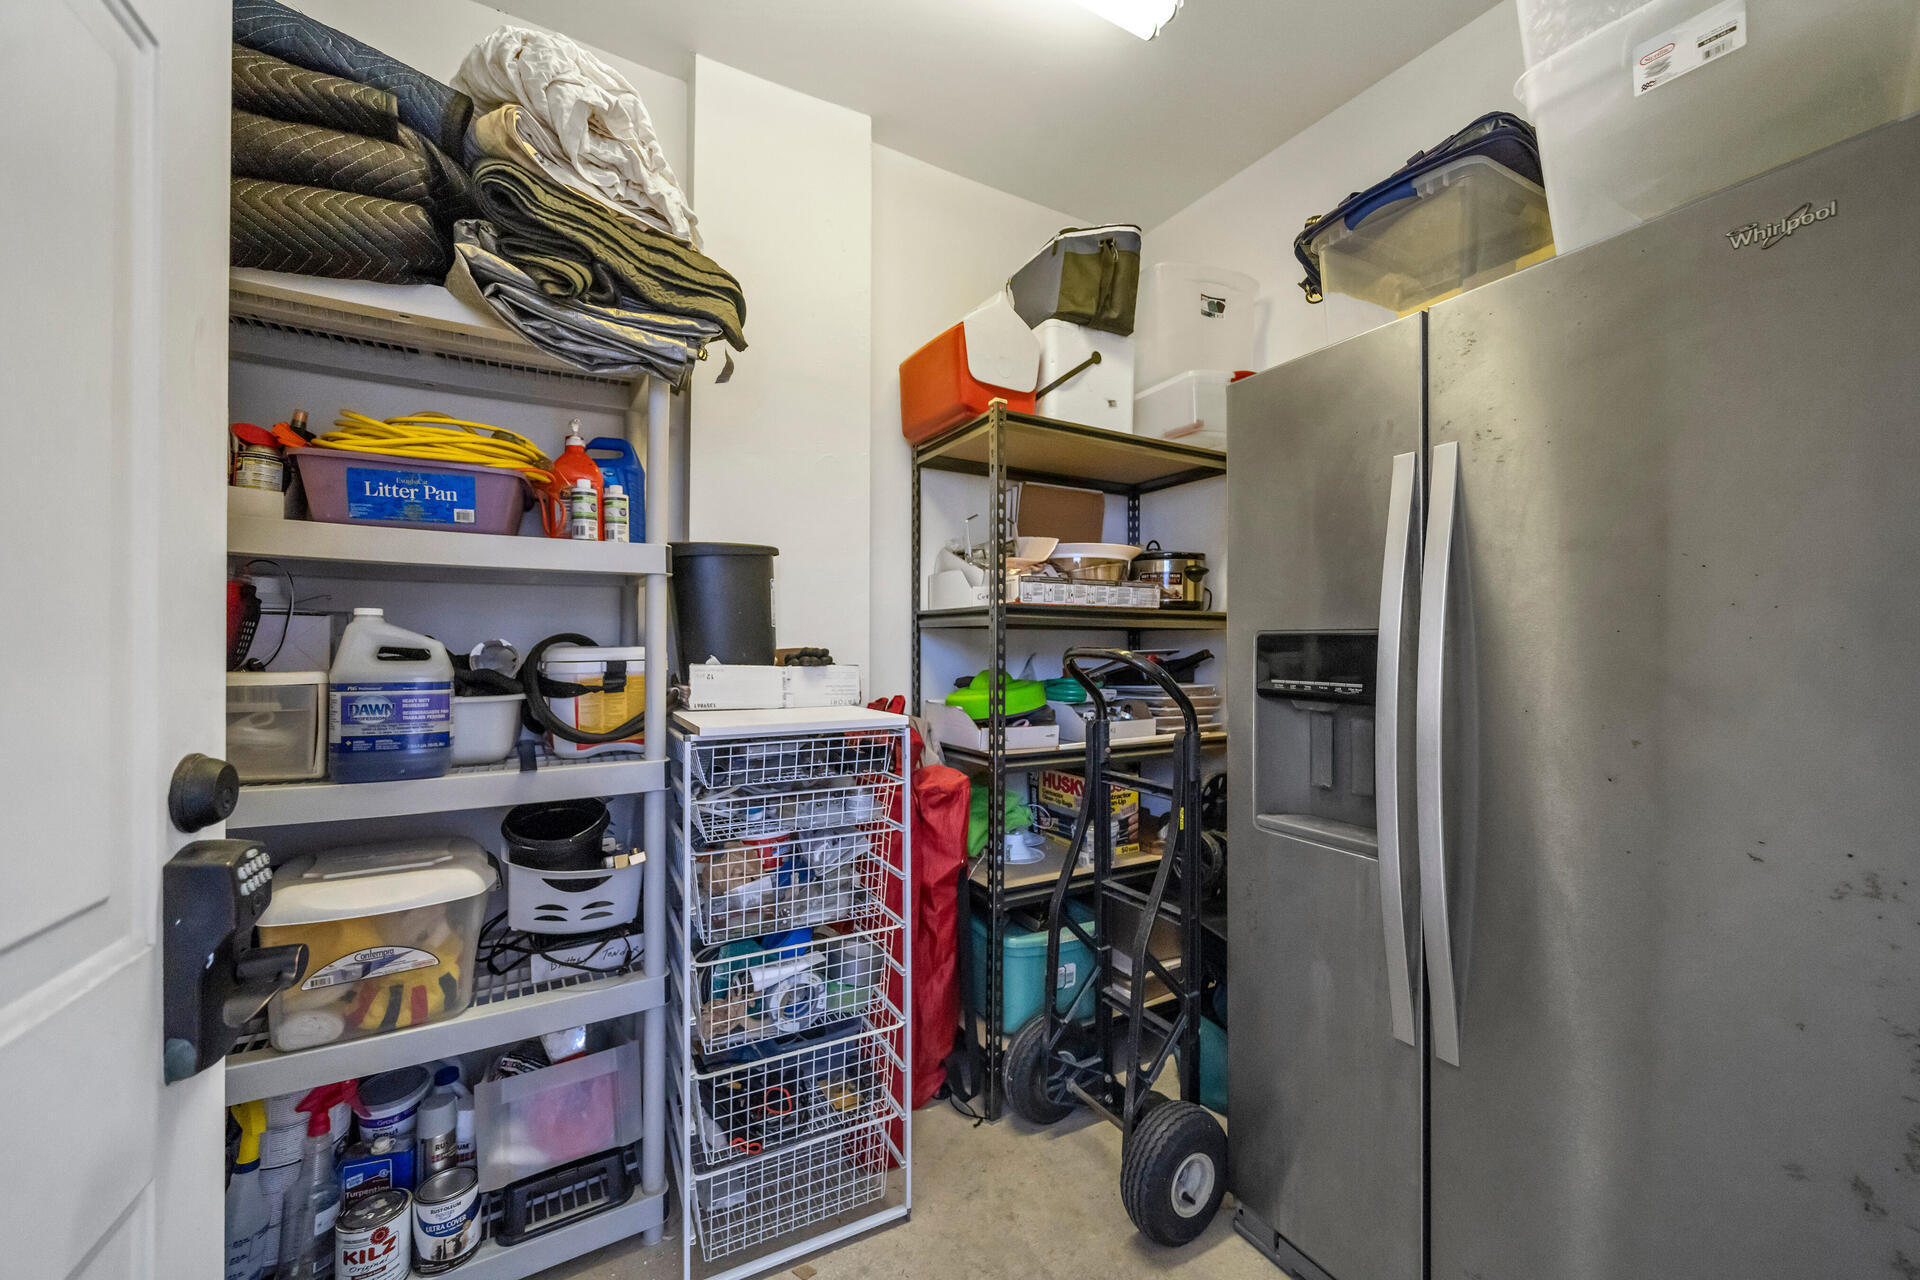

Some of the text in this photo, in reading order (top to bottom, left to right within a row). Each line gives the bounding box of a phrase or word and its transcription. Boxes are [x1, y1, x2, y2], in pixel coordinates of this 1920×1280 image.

[1728, 199, 1837, 249] Whirlpool
[364, 481, 458, 502] Litter Pan
[348, 703, 395, 718] DAWN
[425, 1224, 445, 1233] ULTRA
[446, 1213, 467, 1228] COVER
[343, 1235, 397, 1266] KILZ
